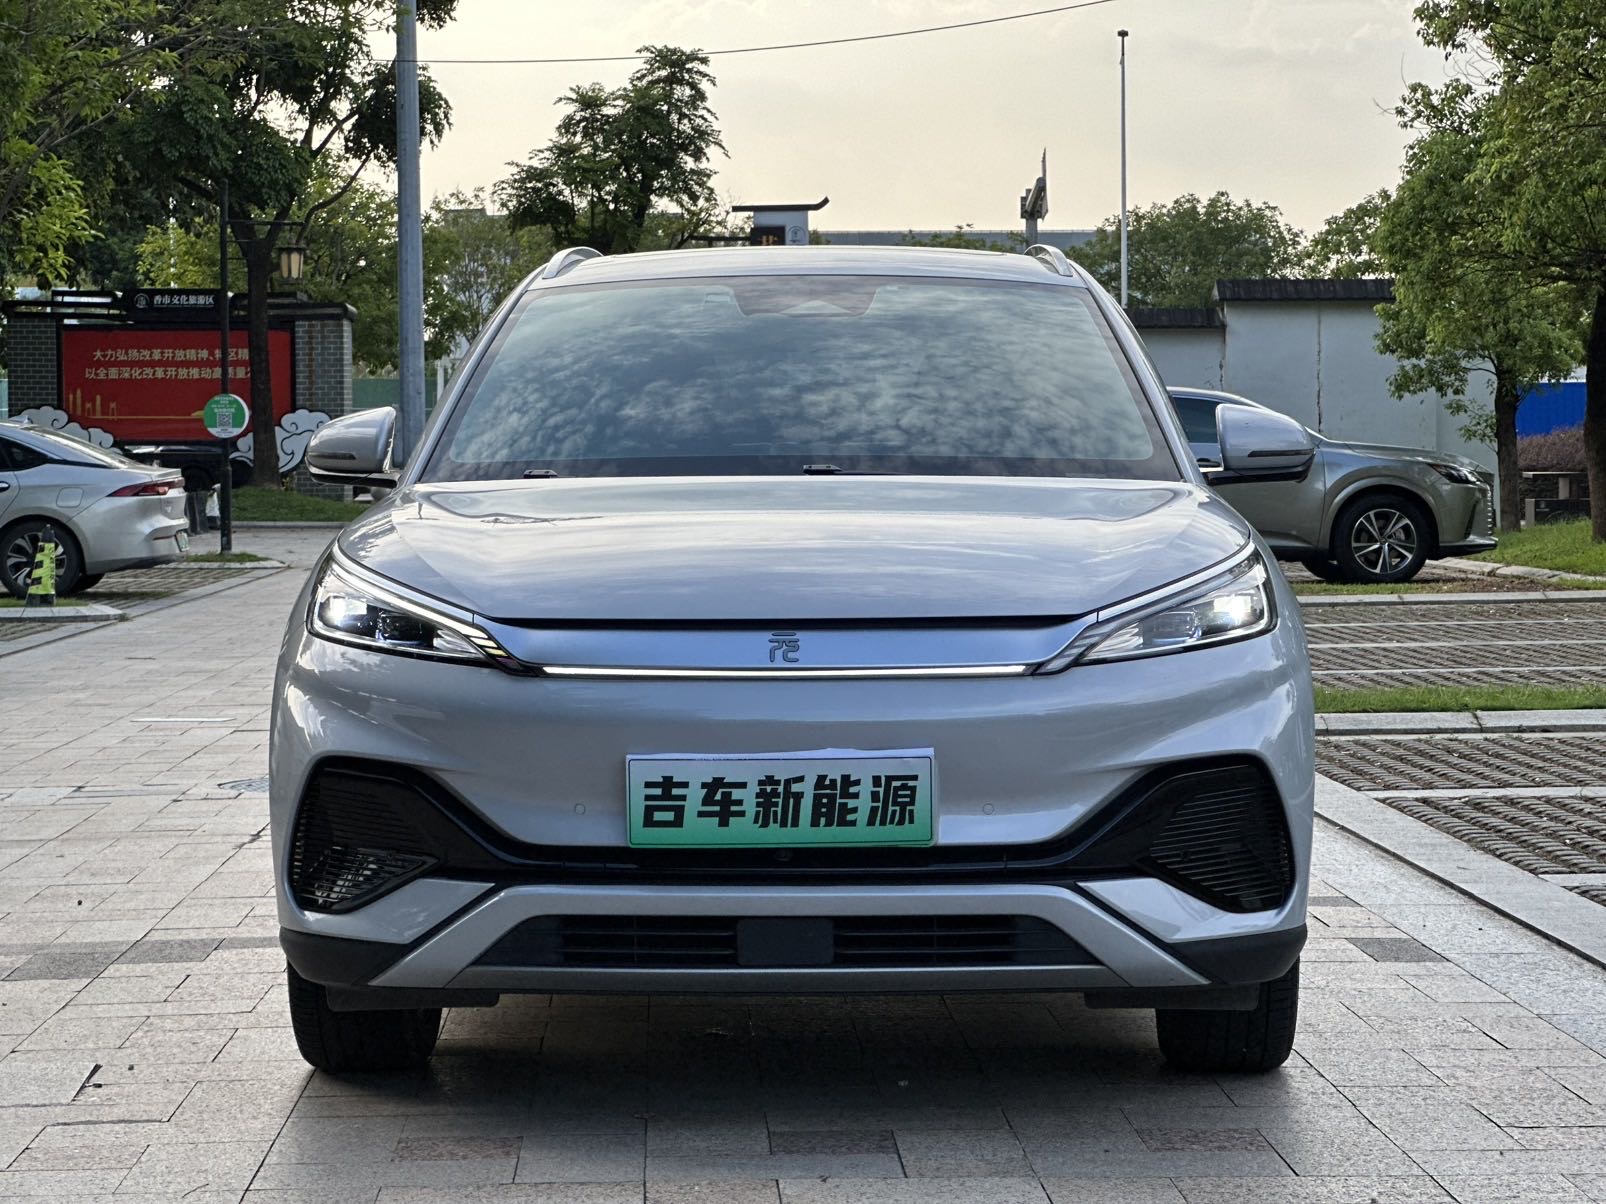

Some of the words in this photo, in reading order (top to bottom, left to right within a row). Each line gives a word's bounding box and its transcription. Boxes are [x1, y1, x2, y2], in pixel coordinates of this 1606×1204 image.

[85, 367, 251, 379] 以全面深化改革开放推动高质量
[642, 773, 920, 829] 吉车新能源
